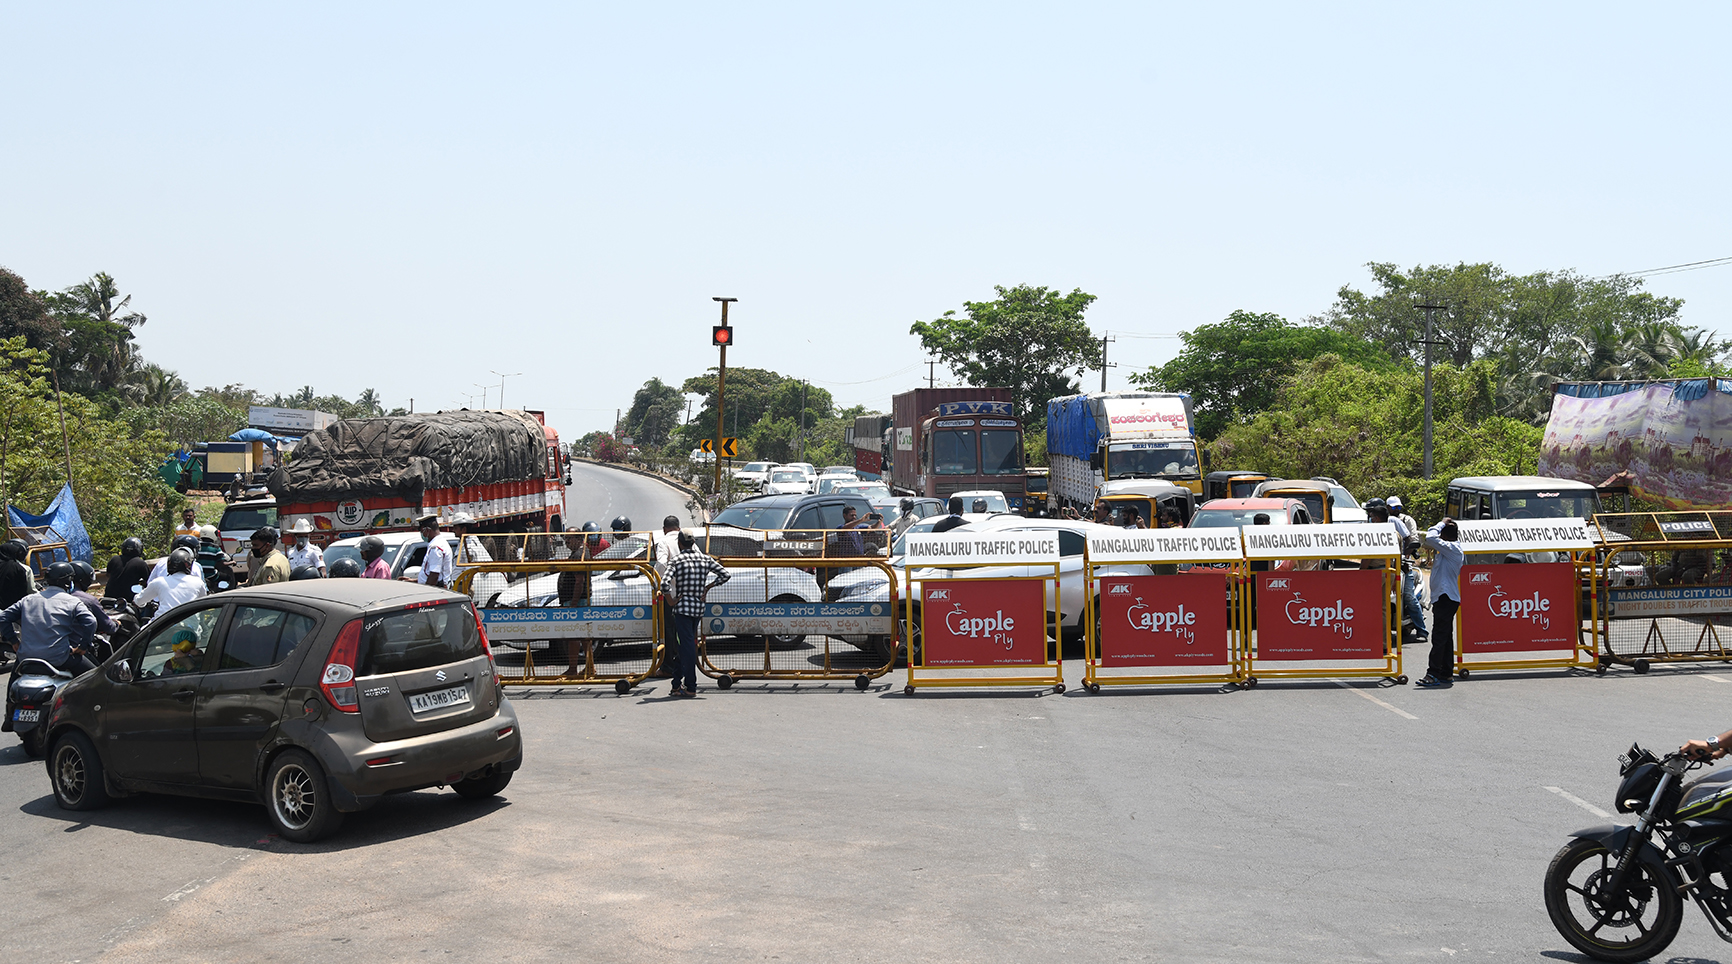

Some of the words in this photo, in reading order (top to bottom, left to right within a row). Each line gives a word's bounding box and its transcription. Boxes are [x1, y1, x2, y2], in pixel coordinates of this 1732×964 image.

[944, 402, 1009, 415] P.V.K
[344, 505, 357, 516] AIP
[1513, 527, 1551, 542] TRAFFIC
[1552, 526, 1587, 541] POLICE
[1661, 521, 1712, 532] POLICE
[773, 541, 815, 550] POLICE
[909, 540, 972, 557] MANGALURU
[975, 540, 1016, 556] TRAFFIC
[1018, 539, 1055, 555] POLICE
[1092, 537, 1154, 554] MANGALURU
[1156, 536, 1199, 552] TRAFFIC
[1201, 535, 1237, 551] POLICE
[1249, 533, 1312, 549] MANGALURU
[1313, 532, 1356, 548] TRAFFIC
[1357, 531, 1394, 547] POLICE
[1268, 579, 1288, 588] AK
[1471, 573, 1490, 582] AK
[928, 590, 948, 599] AK
[1110, 584, 1130, 593] AK
[1617, 590, 1680, 600] MANGALURU
[1683, 589, 1707, 598] CITY
[1709, 588, 1732, 597] POLI
[728, 606, 786, 616] ಮಂಗಳೂರು
[790, 605, 816, 616] ನಗರ
[820, 604, 865, 616] ಪೊಲೀಸ್
[1298, 599, 1354, 627] apple
[1500, 591, 1550, 619] apple
[1618, 602, 1641, 611] NIGHT
[1643, 601, 1676, 610] DOUBLES
[1677, 600, 1708, 609] TRAFFIC
[490, 610, 548, 621] ಮಂಗಳೂರು
[552, 609, 578, 620] ನಗರ
[583, 608, 627, 619] ಪೊಲೀಸ್
[1140, 604, 1196, 632] apple
[1532, 613, 1550, 631] Ply
[959, 609, 1014, 638] apple
[1333, 622, 1353, 640] Ply
[994, 633, 1014, 651] Ply
[1175, 627, 1195, 645] Ply
[1617, 846, 1632, 872] YAMAHA
